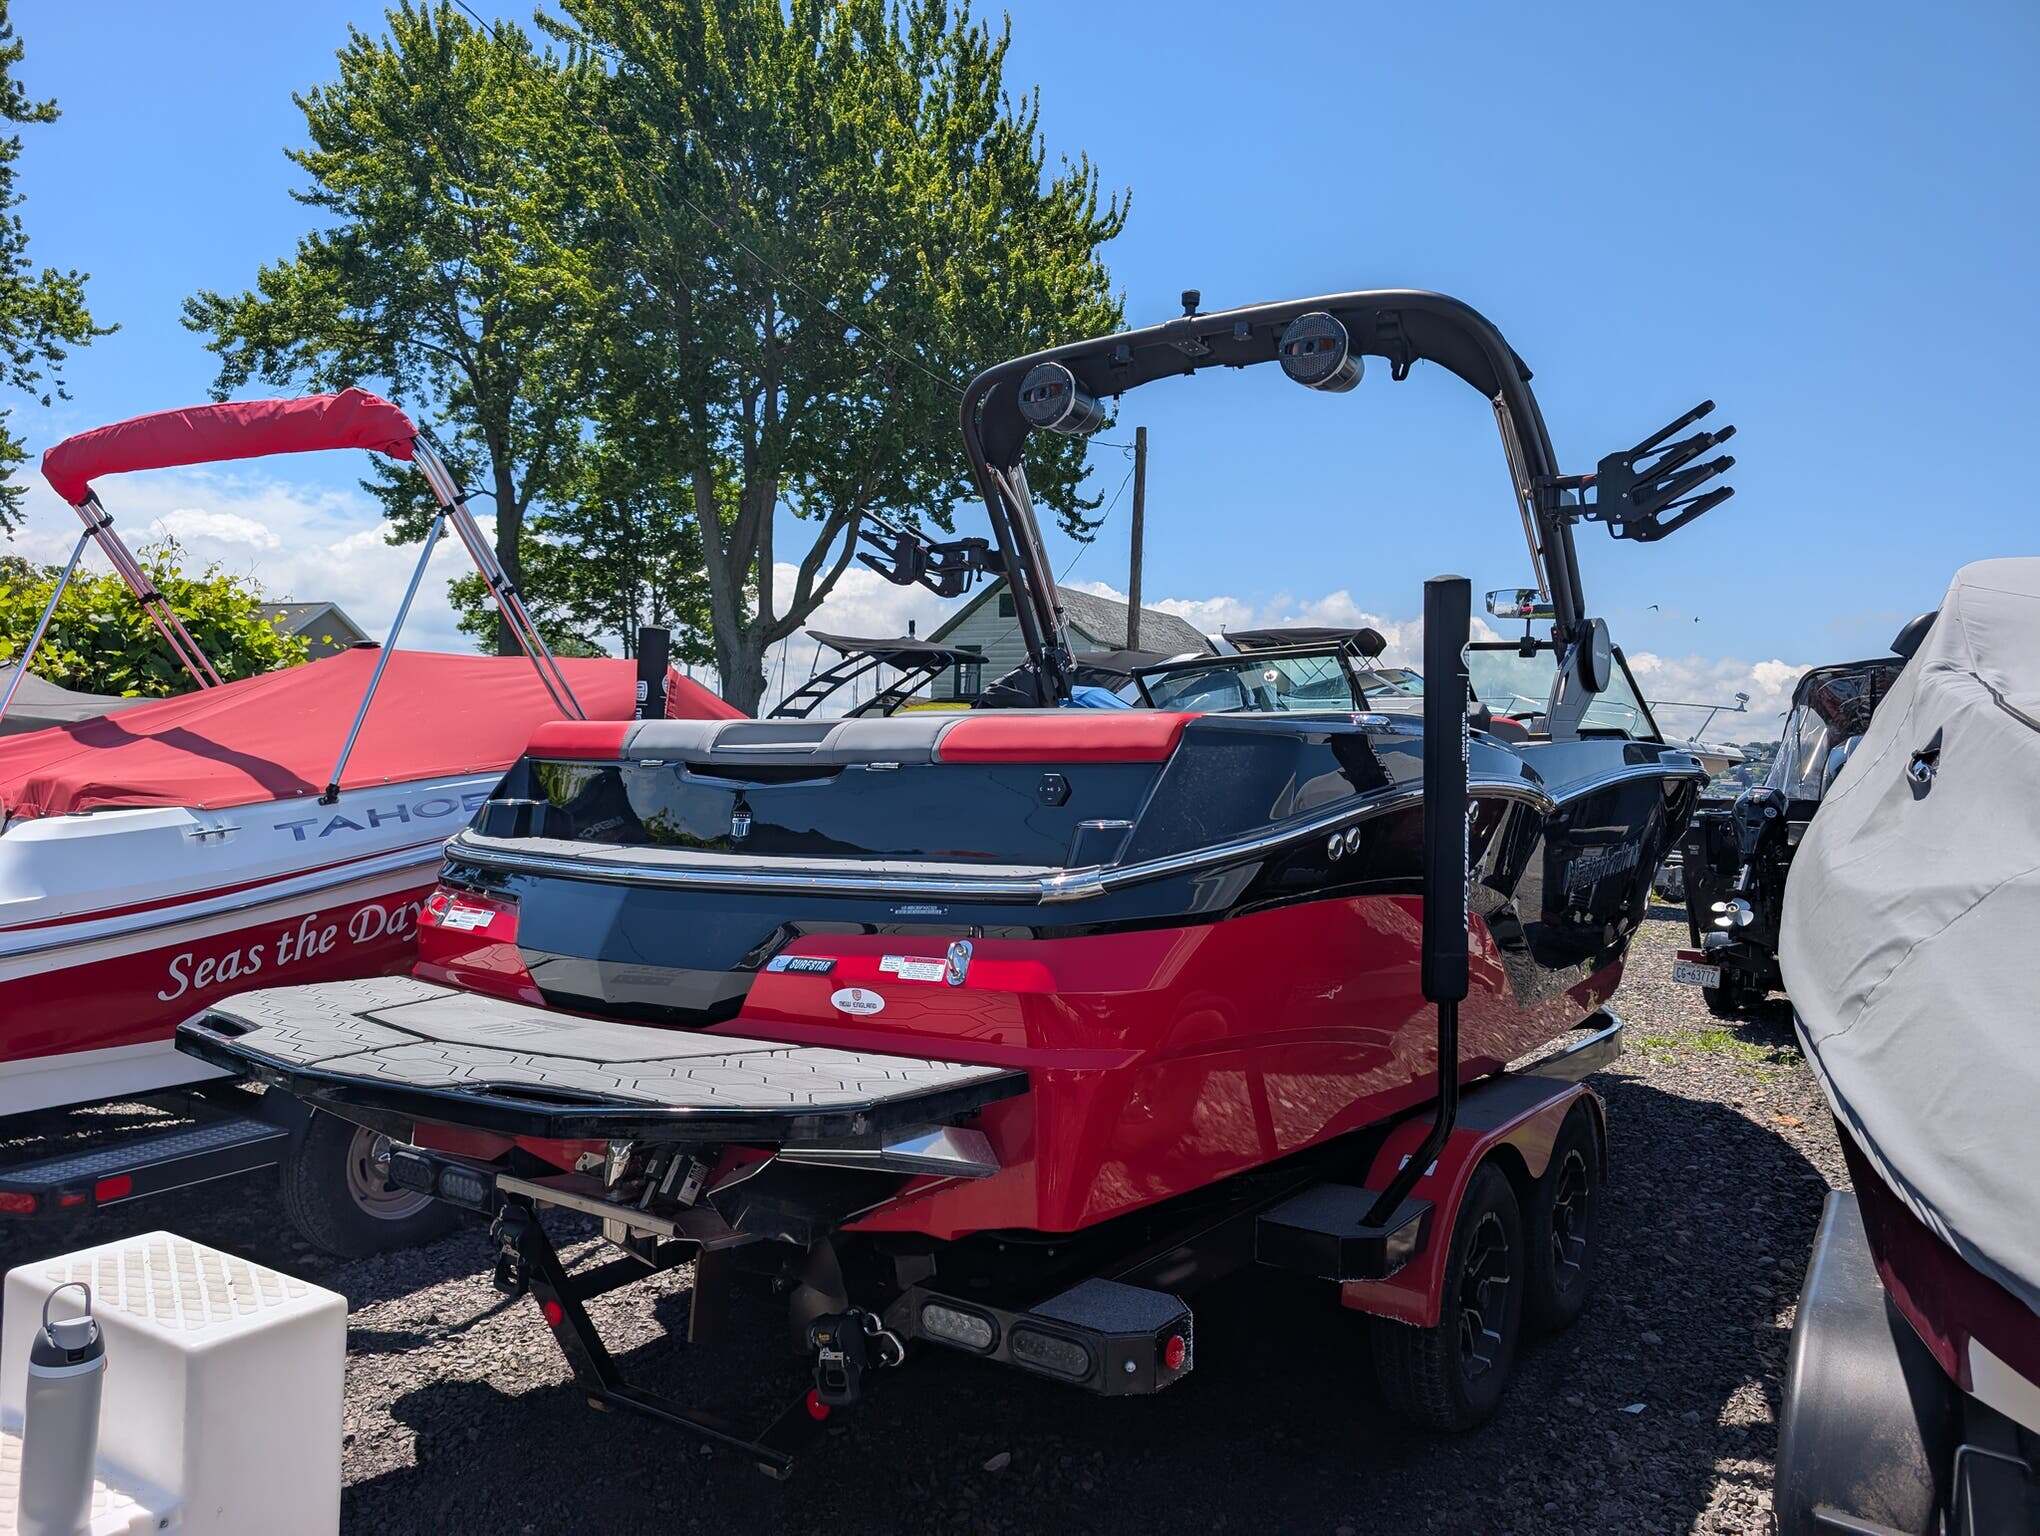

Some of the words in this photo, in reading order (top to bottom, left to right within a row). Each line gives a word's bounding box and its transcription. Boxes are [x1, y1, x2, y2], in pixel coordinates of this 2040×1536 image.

[274, 792, 490, 841] TAHOE
[157, 944, 265, 1001] Seas
[276, 914, 338, 967] the
[348, 902, 420, 944] Day
[789, 958, 832, 972] SURFSTAR
